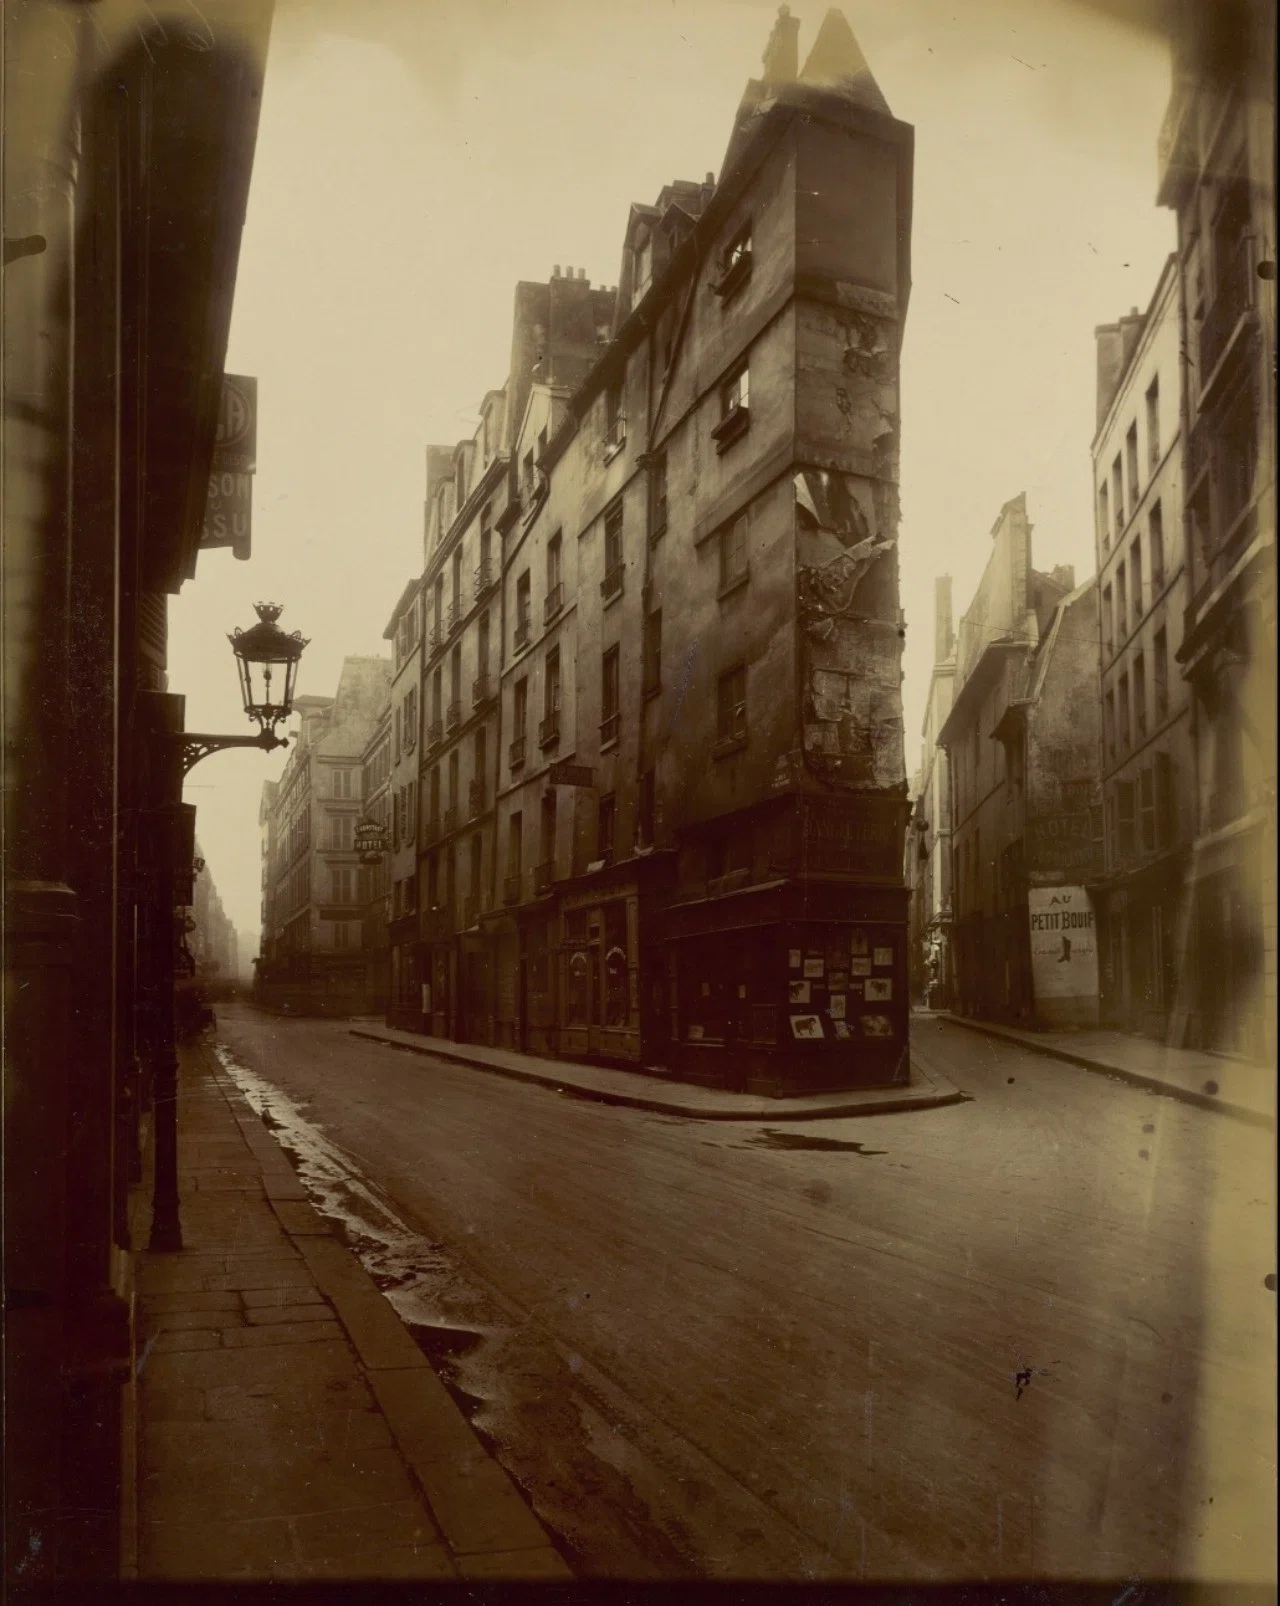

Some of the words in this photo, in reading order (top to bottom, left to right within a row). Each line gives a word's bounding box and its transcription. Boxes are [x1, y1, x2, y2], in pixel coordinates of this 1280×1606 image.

[1035, 818, 1089, 840] HOTEL
[356, 840, 382, 850] HOTEL
[1049, 895, 1072, 907] AU
[1031, 912, 1060, 931] PETIT
